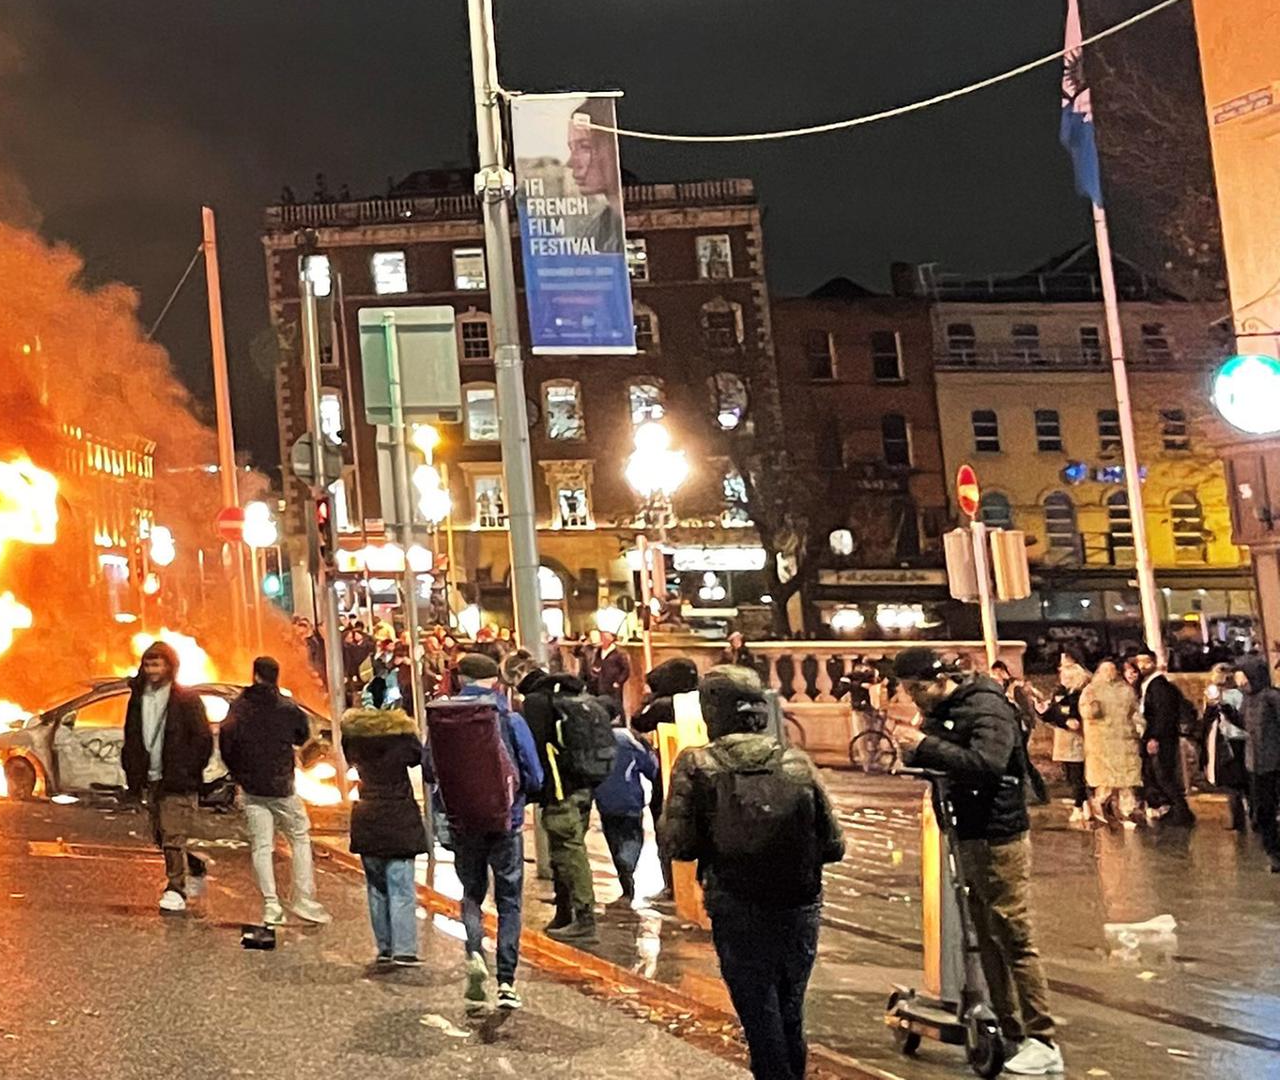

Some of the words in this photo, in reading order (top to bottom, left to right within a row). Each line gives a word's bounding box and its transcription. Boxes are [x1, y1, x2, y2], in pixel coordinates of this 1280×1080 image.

[525, 178, 544, 196] IFI
[527, 196, 588, 216] FRENCH
[528, 218, 564, 236] FILM
[530, 237, 600, 256] FESTIVAL
